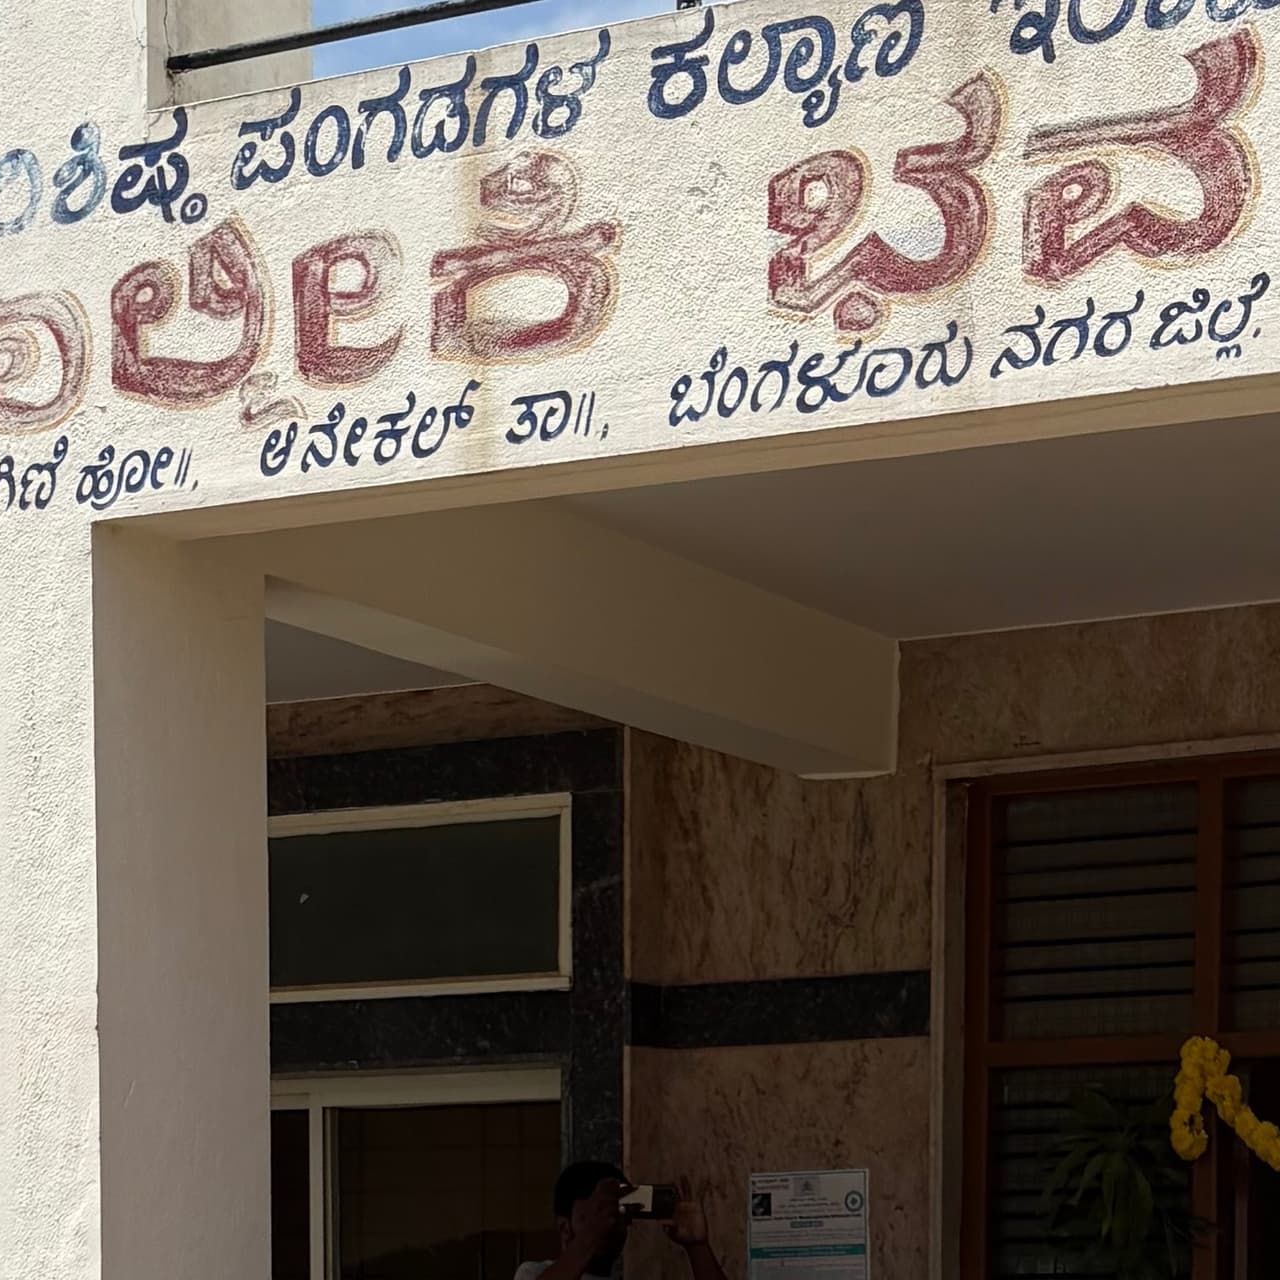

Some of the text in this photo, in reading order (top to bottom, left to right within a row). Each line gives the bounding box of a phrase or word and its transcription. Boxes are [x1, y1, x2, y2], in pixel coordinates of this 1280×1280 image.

[230, 28, 612, 191] ಪಂಗಡಗಳ
[646, 0, 929, 128] ಕಲ್ಯಾಣ
[990, 290, 1144, 379] ನಗರ
